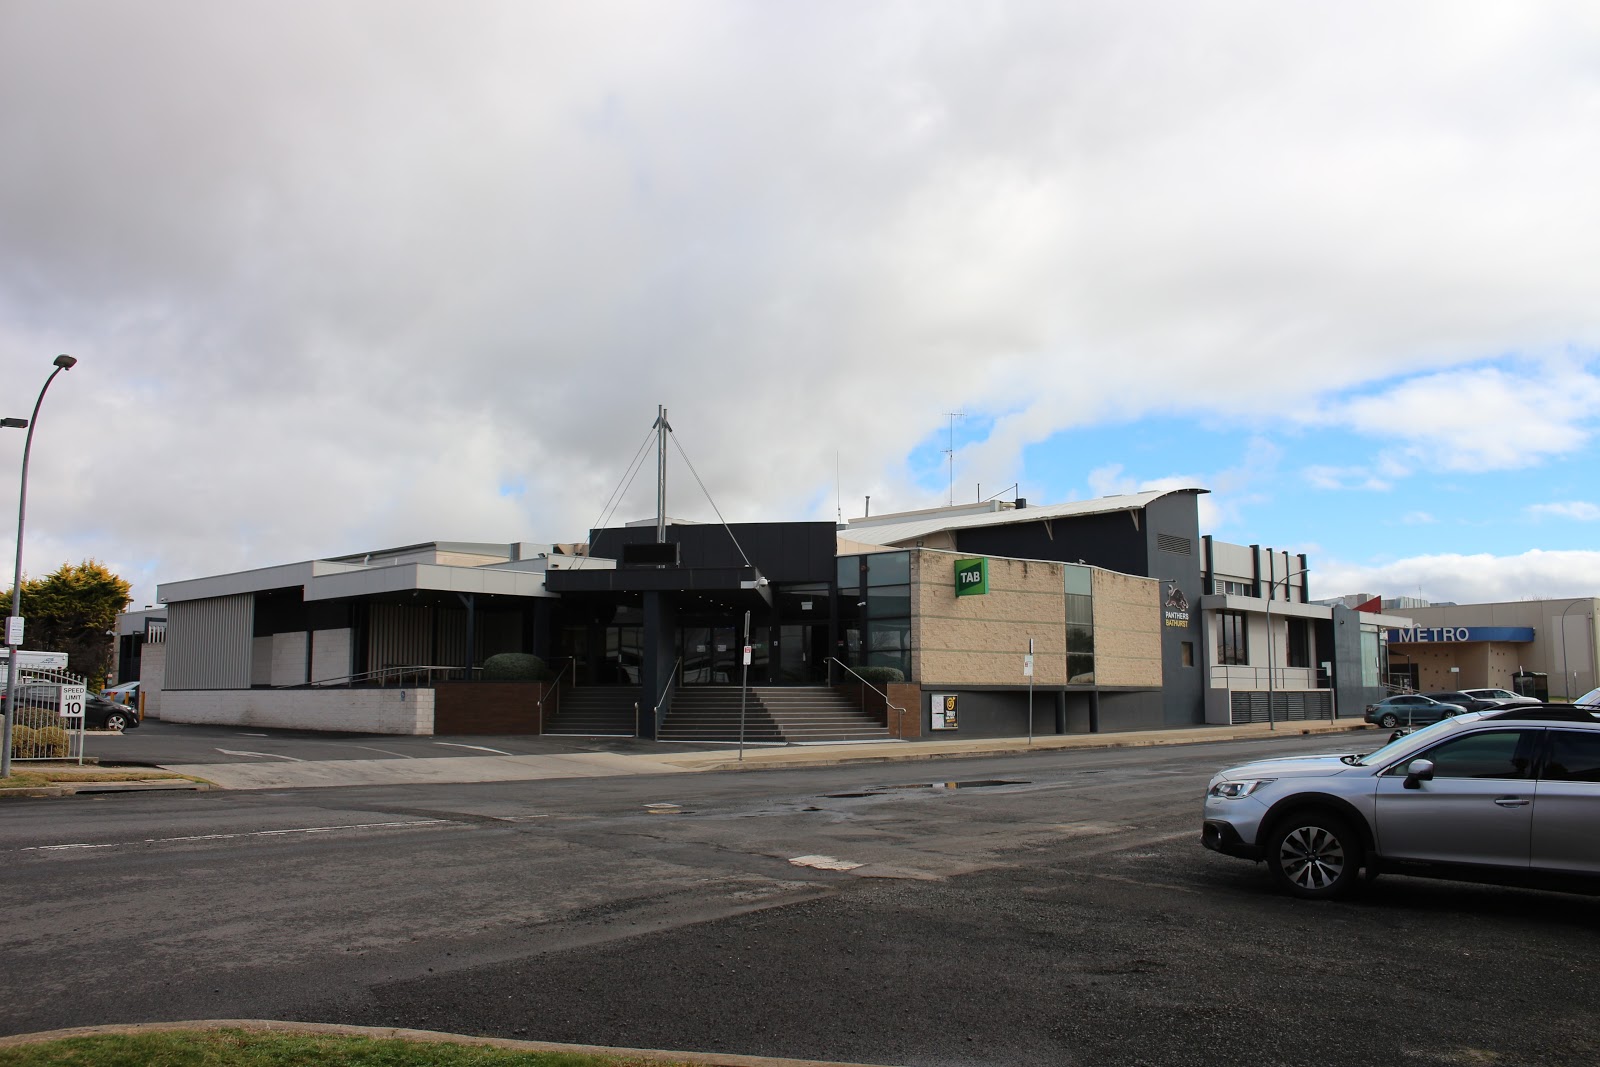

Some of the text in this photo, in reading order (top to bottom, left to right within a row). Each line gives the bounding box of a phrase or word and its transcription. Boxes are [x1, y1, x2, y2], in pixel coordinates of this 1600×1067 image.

[960, 571, 981, 583] TAB
[1165, 611, 1189, 620] PANTHERS
[1165, 619, 1188, 628] BATHURST
[1398, 627, 1469, 643] METRO
[64, 702, 81, 714] 10
